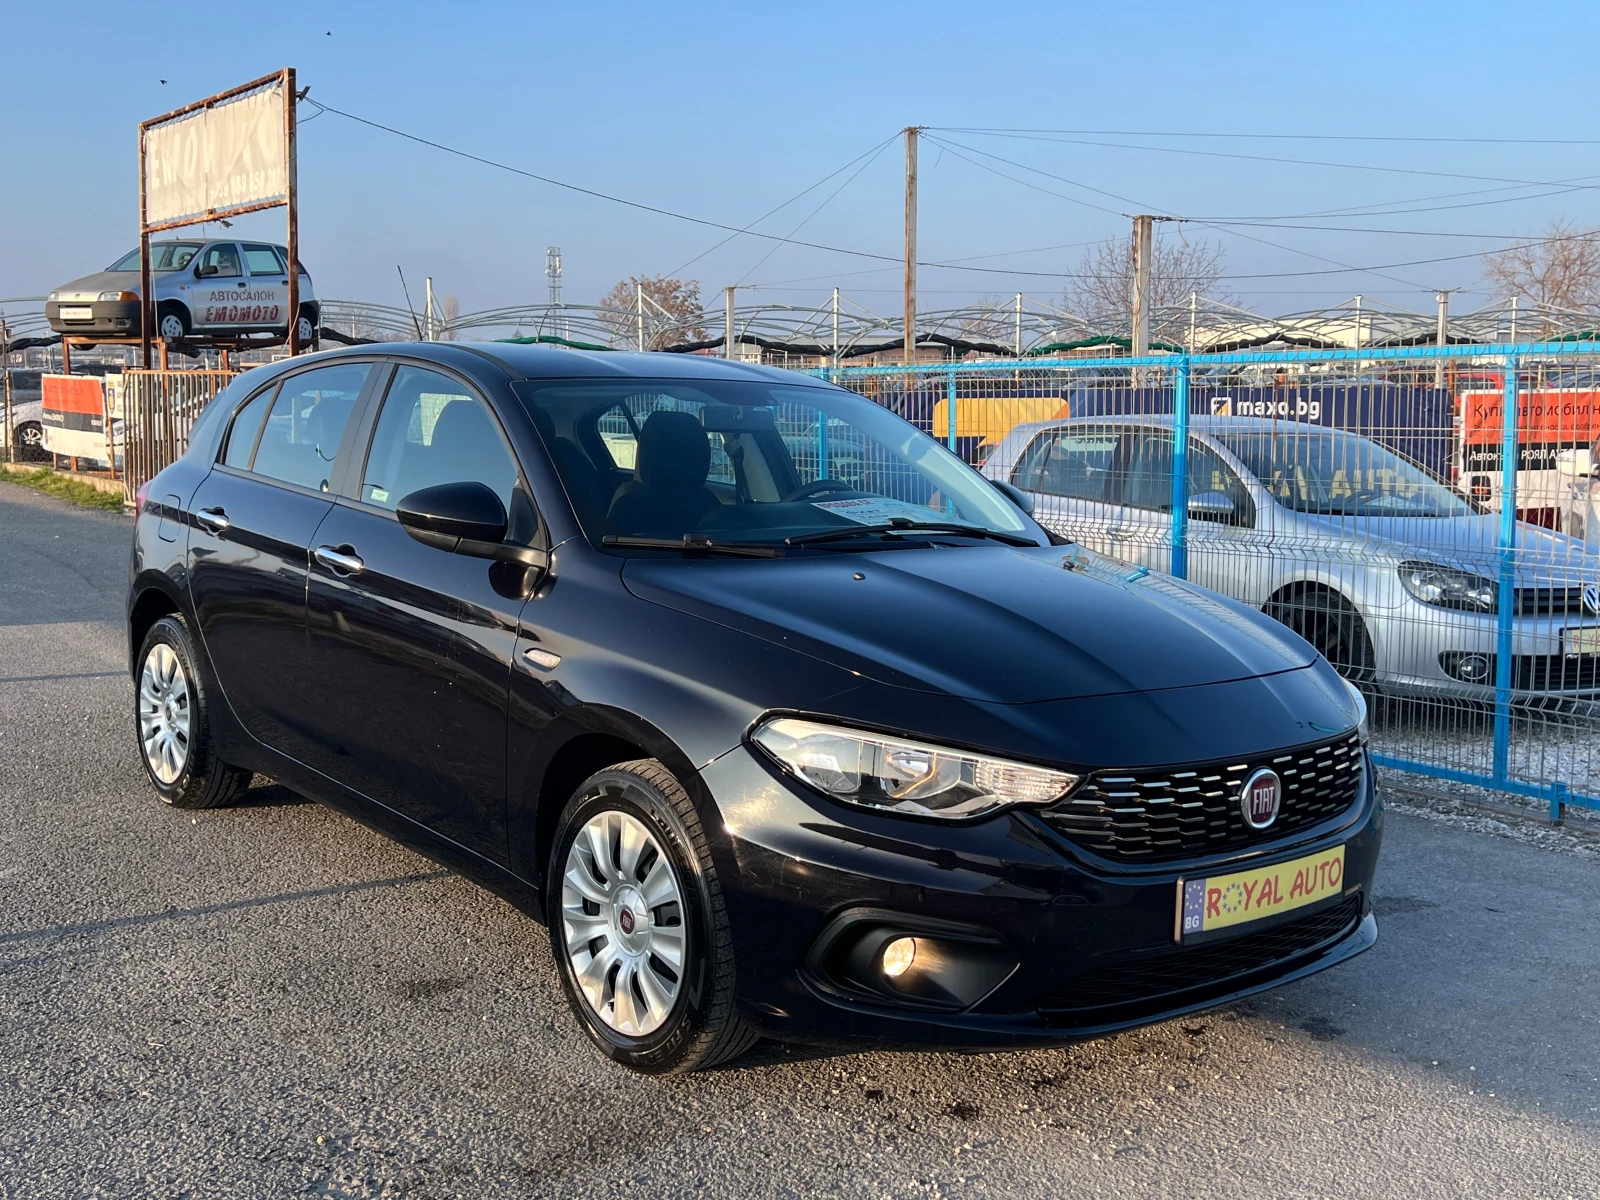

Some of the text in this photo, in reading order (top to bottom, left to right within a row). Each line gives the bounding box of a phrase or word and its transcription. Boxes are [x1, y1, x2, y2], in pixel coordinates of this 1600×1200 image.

[210, 290, 274, 301] АВТОСАЛОН
[1237, 397, 1320, 419] maxo.bg
[1521, 449, 1547, 460] РОЯЛ
[1253, 786, 1275, 815] FIAT
[1207, 857, 1342, 919] ROYAL AUTO
[1185, 915, 1200, 930] BG
